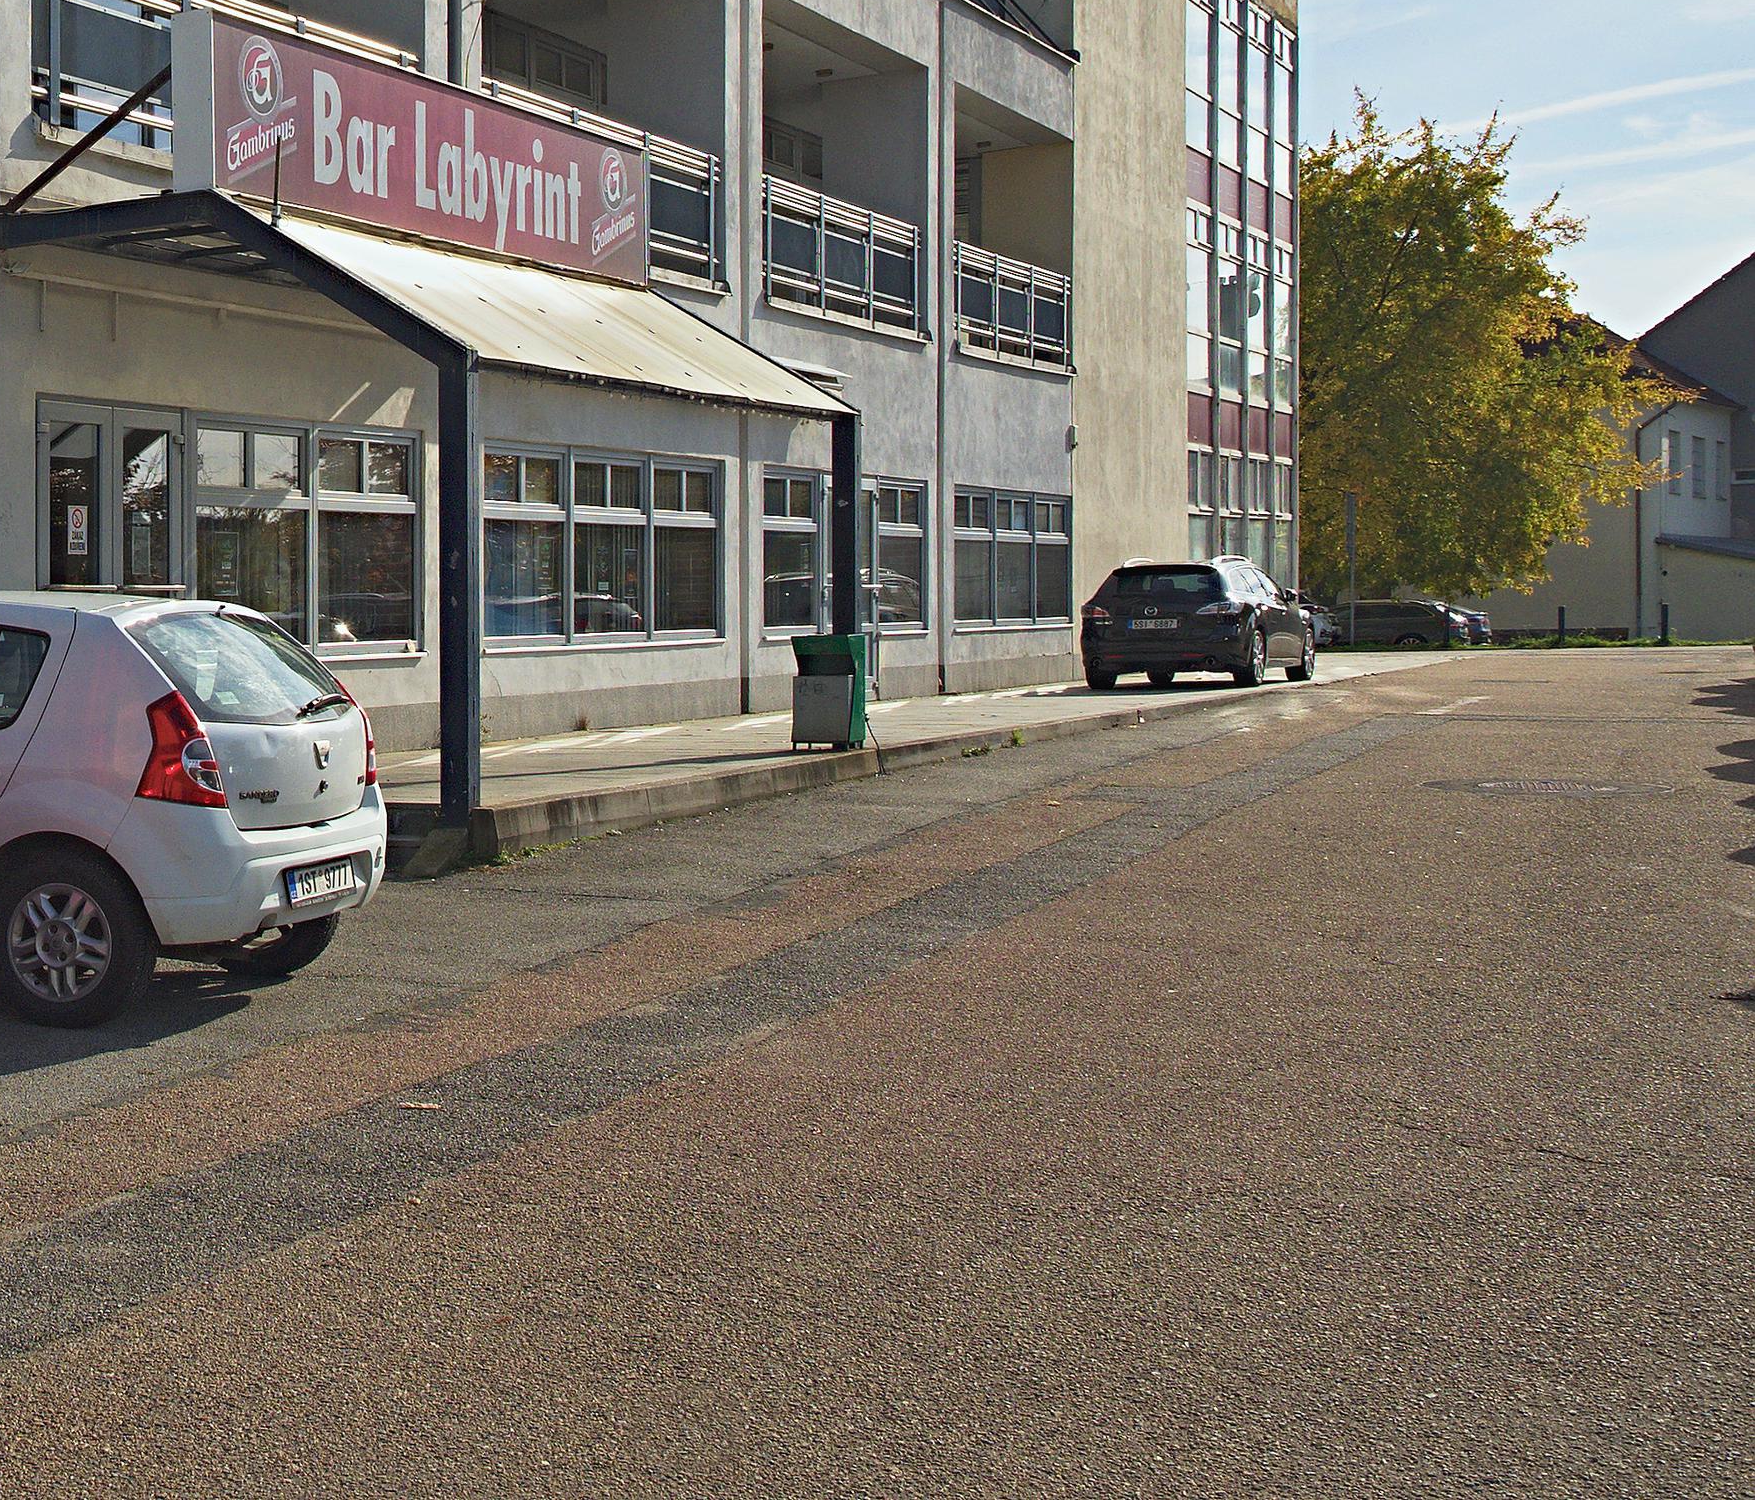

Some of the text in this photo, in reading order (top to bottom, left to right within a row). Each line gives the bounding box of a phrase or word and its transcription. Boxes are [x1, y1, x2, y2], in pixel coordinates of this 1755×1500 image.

[227, 118, 295, 171] Gambrinus
[312, 69, 582, 253] Bar Labyrint
[298, 872, 318, 896] 1ST
[324, 863, 348, 889] 9777
